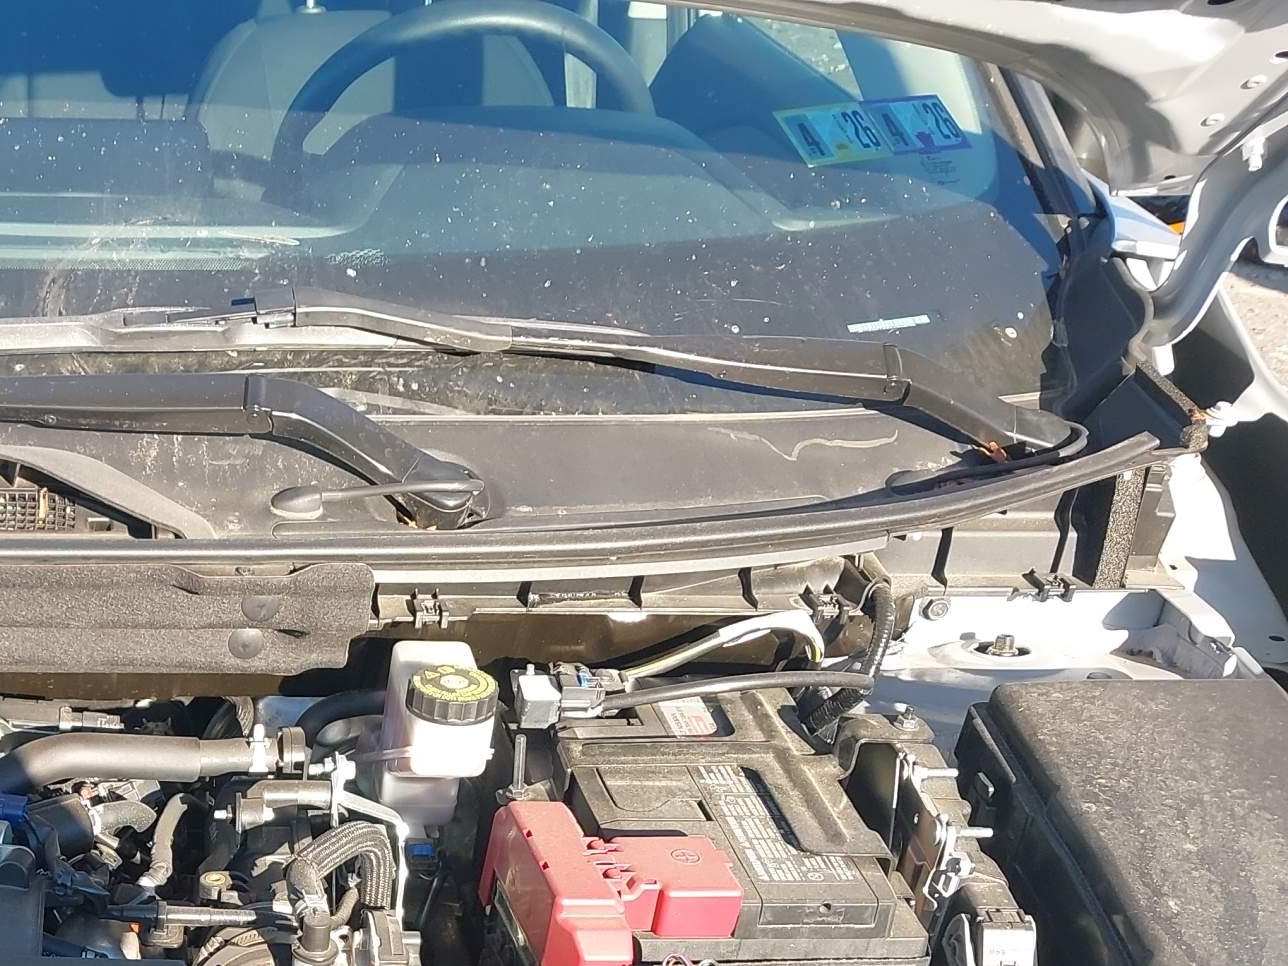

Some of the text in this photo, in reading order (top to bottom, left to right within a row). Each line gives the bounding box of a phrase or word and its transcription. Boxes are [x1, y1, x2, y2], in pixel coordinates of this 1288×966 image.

[797, 110, 881, 156] 4 26
[881, 102, 961, 148] 4 26
